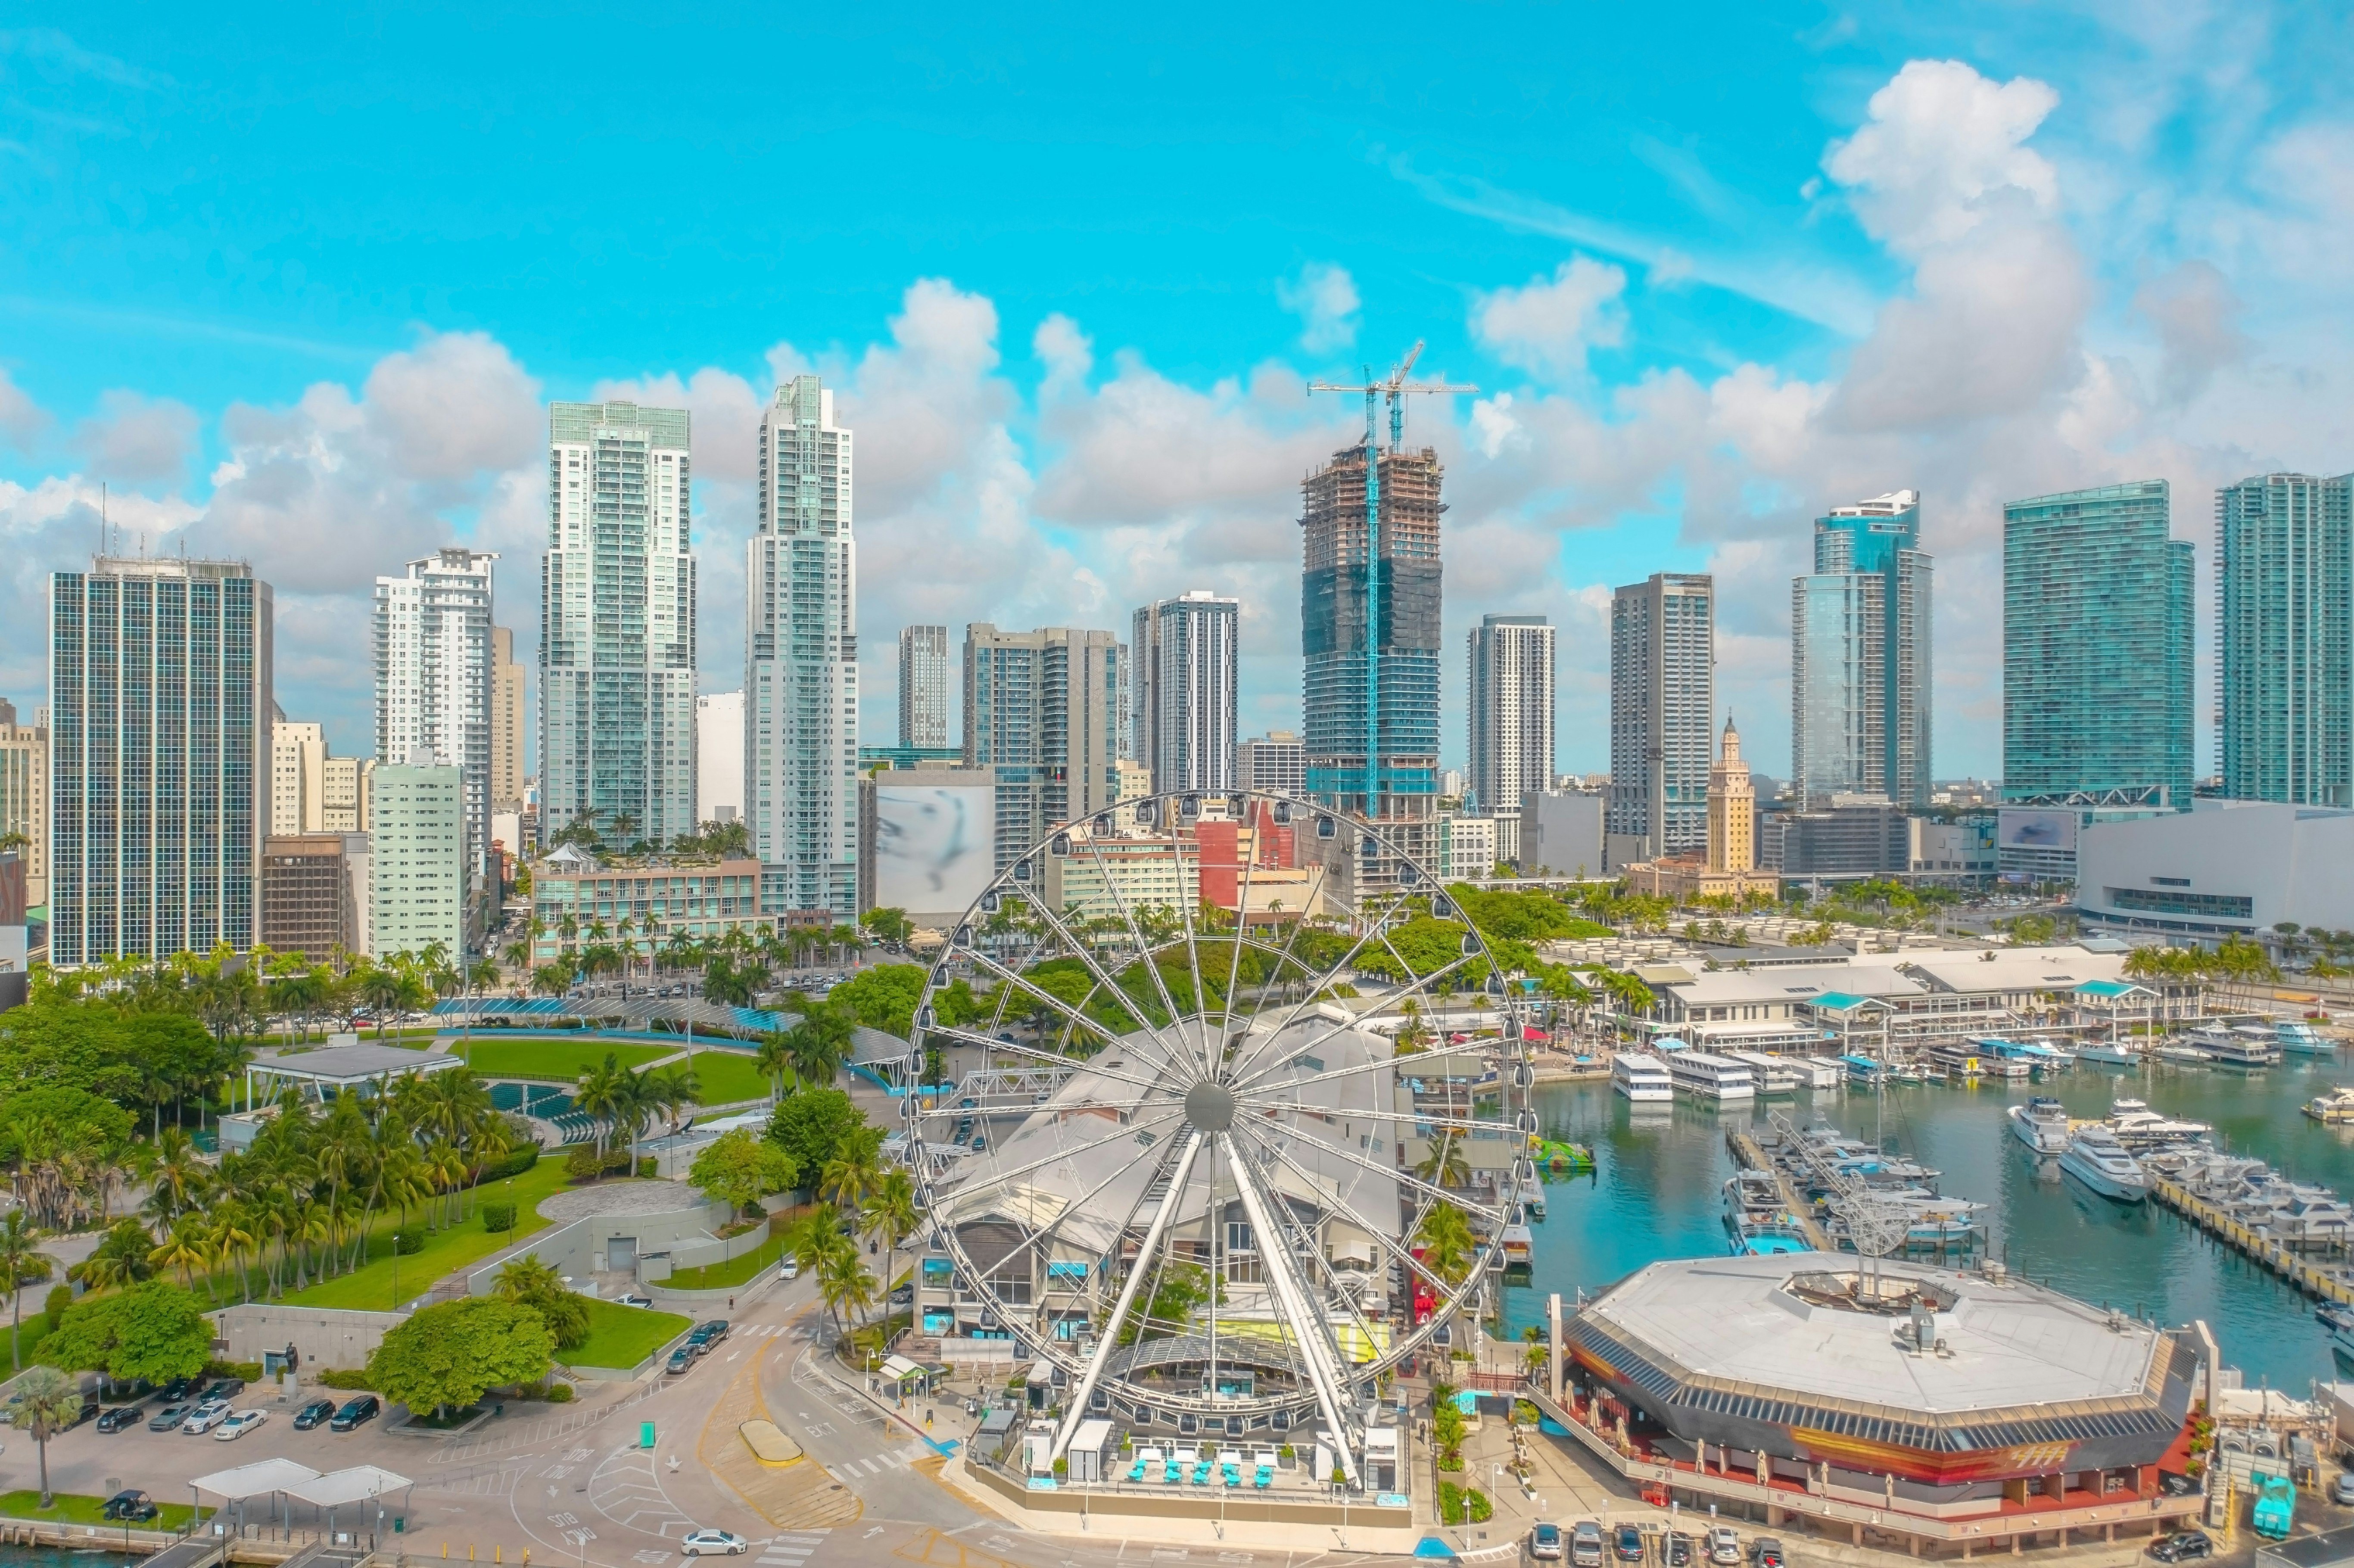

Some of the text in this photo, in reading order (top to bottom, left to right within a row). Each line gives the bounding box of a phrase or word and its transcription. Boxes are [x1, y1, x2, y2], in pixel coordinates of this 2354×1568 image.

[838, 1401, 868, 1413] BUS
[805, 1422, 837, 1437] EXIT
[562, 1449, 595, 1461] BUS
[536, 1464, 575, 1479] ONLY
[547, 1512, 579, 1527] BUS
